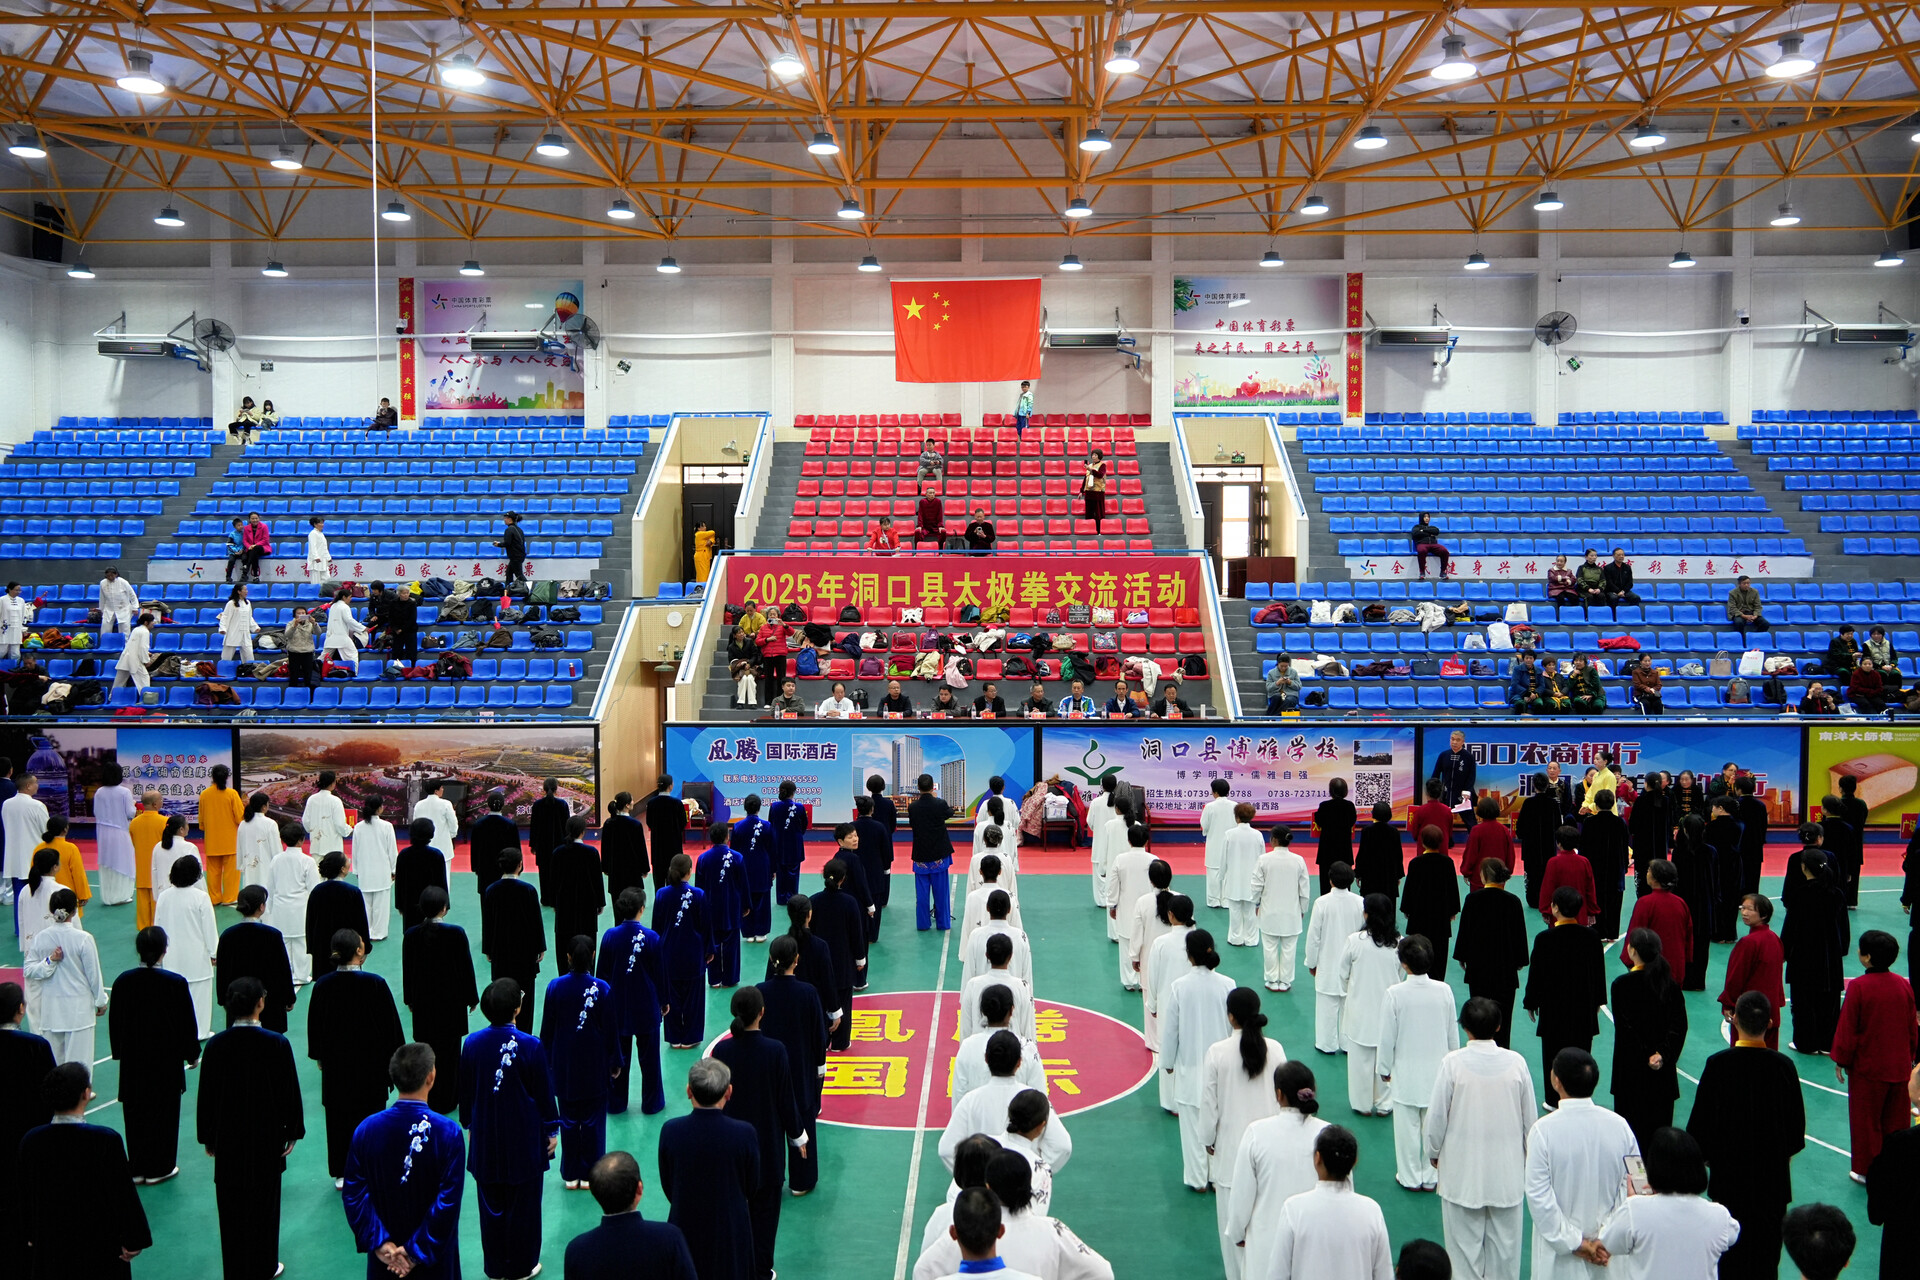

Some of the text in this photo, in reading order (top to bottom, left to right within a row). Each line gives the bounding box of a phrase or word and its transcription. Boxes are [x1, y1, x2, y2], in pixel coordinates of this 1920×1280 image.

[451, 296, 492, 304] 中国体育彩票
[1204, 292, 1246, 300] 中国体育彩票
[1214, 318, 1296, 333] 中国体育彩票
[439, 353, 502, 368] 人人参与
[743, 570, 1187, 608] 2025年洞口县太极拳交流活动
[1140, 735, 1340, 764] 洞口县博雅学校
[1146, 789, 1253, 798] 招生热线:0739-9788
